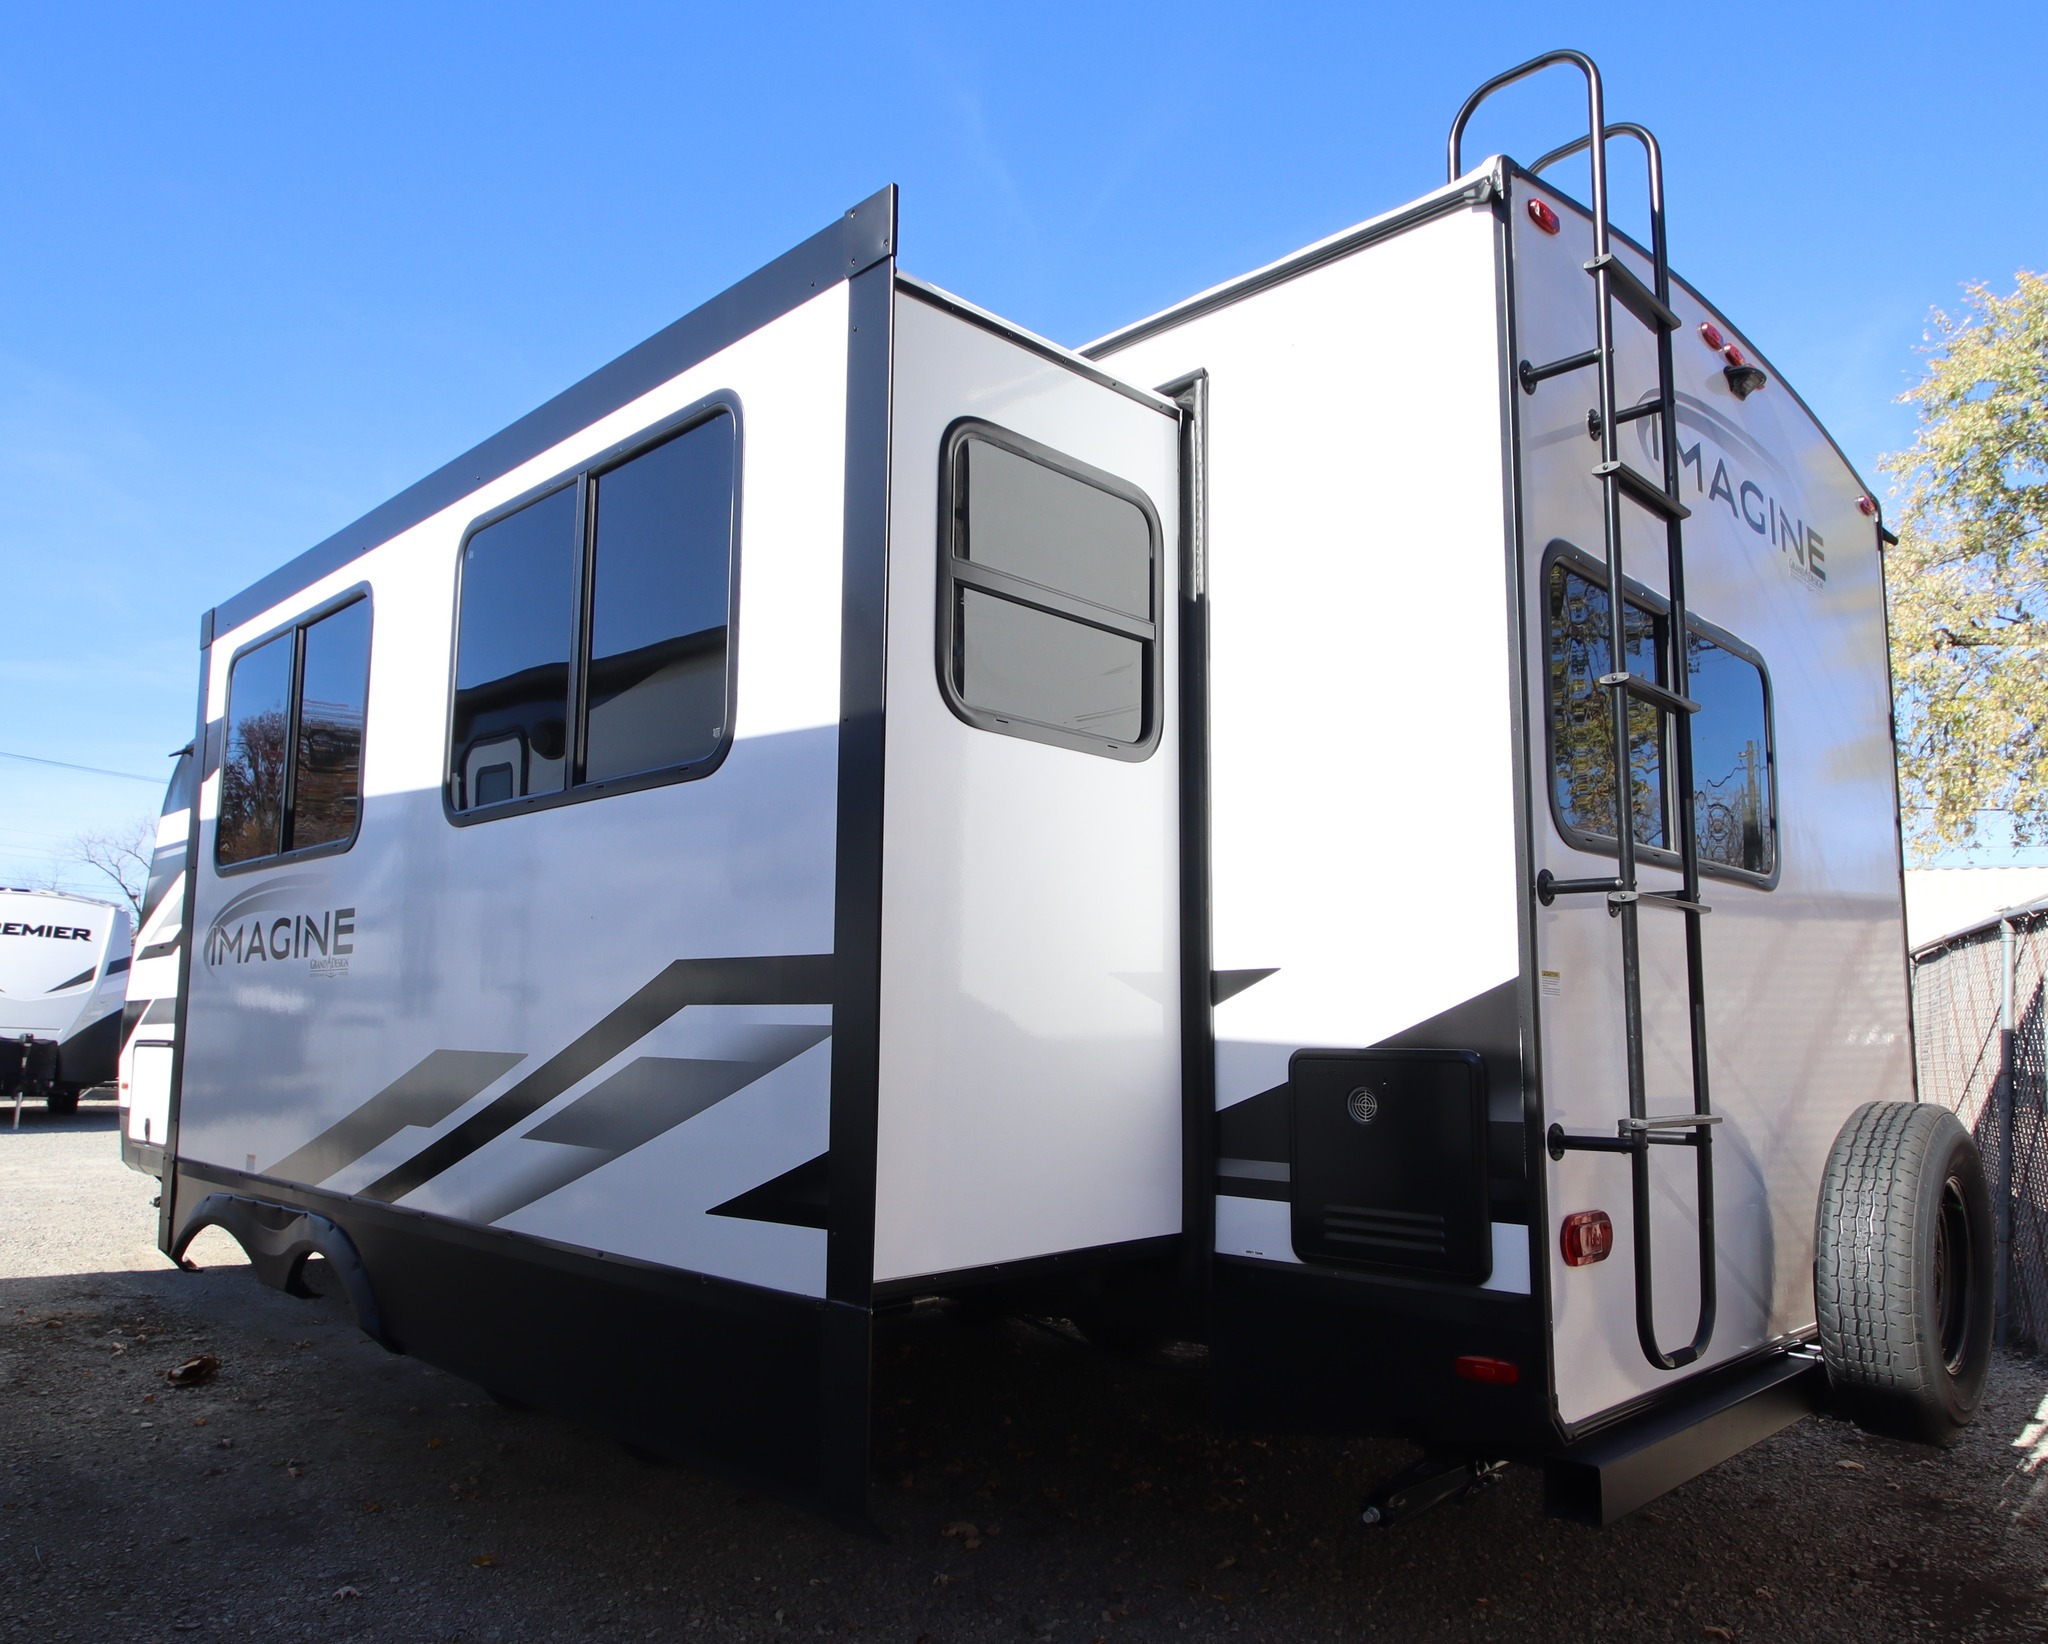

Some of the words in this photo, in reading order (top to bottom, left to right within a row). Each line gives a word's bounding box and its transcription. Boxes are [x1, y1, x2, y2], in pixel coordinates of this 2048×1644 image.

[1651, 412, 1826, 582] IMAGINE
[0, 922, 92, 942] EMIER
[211, 908, 355, 966] IMAGINE
